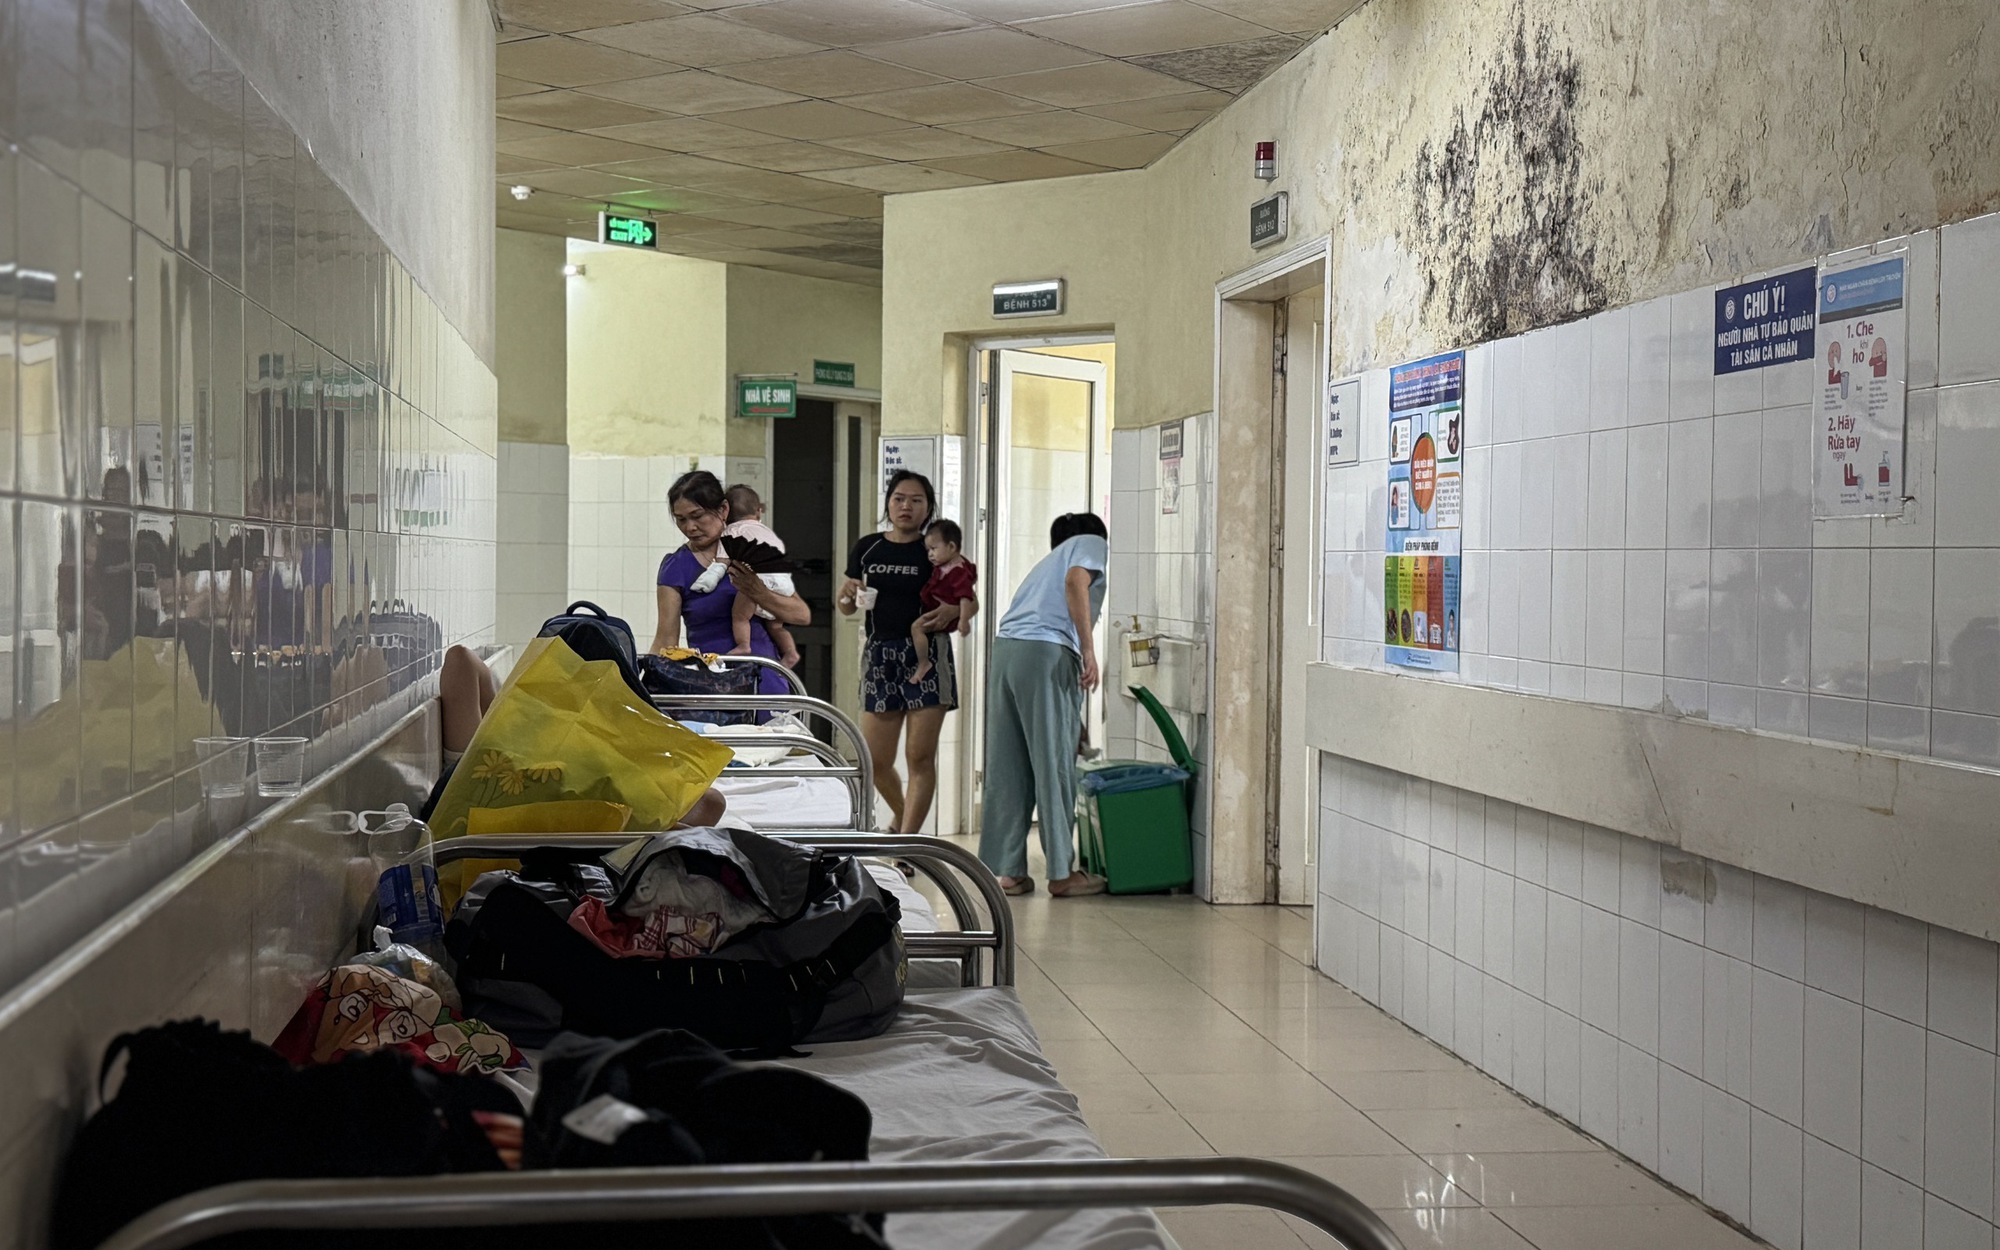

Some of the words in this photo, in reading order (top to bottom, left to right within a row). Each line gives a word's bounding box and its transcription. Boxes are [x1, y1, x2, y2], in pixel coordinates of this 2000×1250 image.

[1004, 299, 1030, 310] BỆNH
[1032, 299, 1048, 308] 513
[1743, 284, 1769, 320] CHÚ
[1772, 281, 1785, 314] Ý!
[1717, 326, 1741, 348] NGƯỜI
[1742, 322, 1759, 343] NHÀ
[1760, 321, 1771, 341] TỰ
[1771, 315, 1788, 337] BẢO
[1790, 310, 1814, 334] QUẢN
[1846, 325, 1854, 338] 1.
[1855, 321, 1874, 338] Che
[1731, 348, 1743, 367] TÀI
[1744, 344, 1761, 364] SẢN
[1762, 342, 1773, 361] CÁ
[1774, 338, 1798, 359] NHÂN
[1852, 348, 1864, 364] ho
[745, 385, 761, 403] NHÀ
[762, 386, 771, 406] VỆ
[772, 389, 791, 403] SINH
[1828, 417, 1836, 432] 2.
[1837, 415, 1856, 433] Hãy
[1828, 433, 1845, 451] Rửa
[1845, 436, 1861, 452] tay
[1833, 451, 1847, 461] ngay
[867, 563, 919, 575] COFFEE
